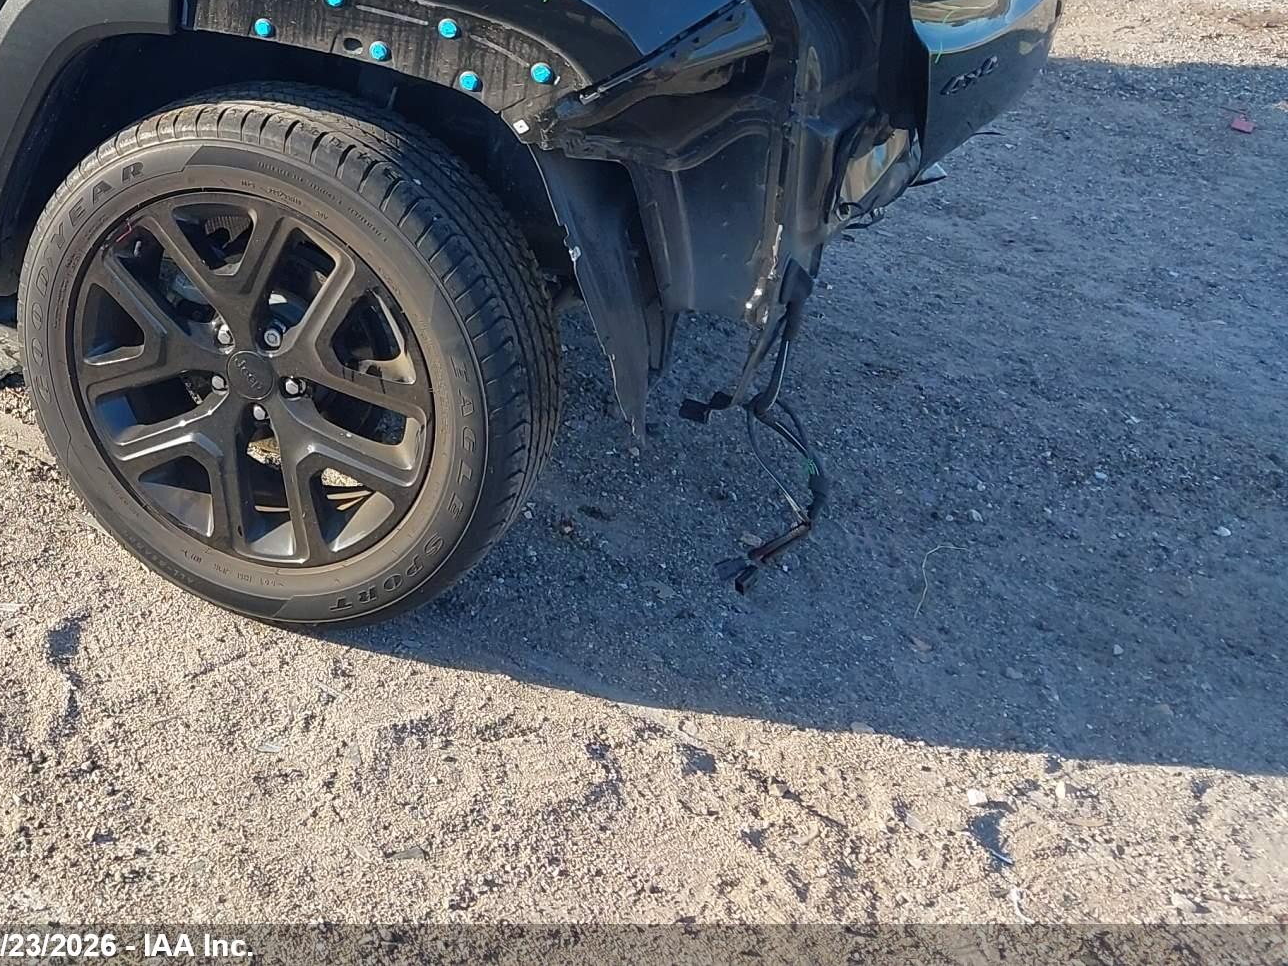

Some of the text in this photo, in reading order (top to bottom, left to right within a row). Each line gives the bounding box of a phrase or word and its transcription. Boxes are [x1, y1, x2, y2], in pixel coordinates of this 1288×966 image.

[31, 161, 144, 403] GOODYEAR
[329, 355, 477, 611] EAGLE SPORT
